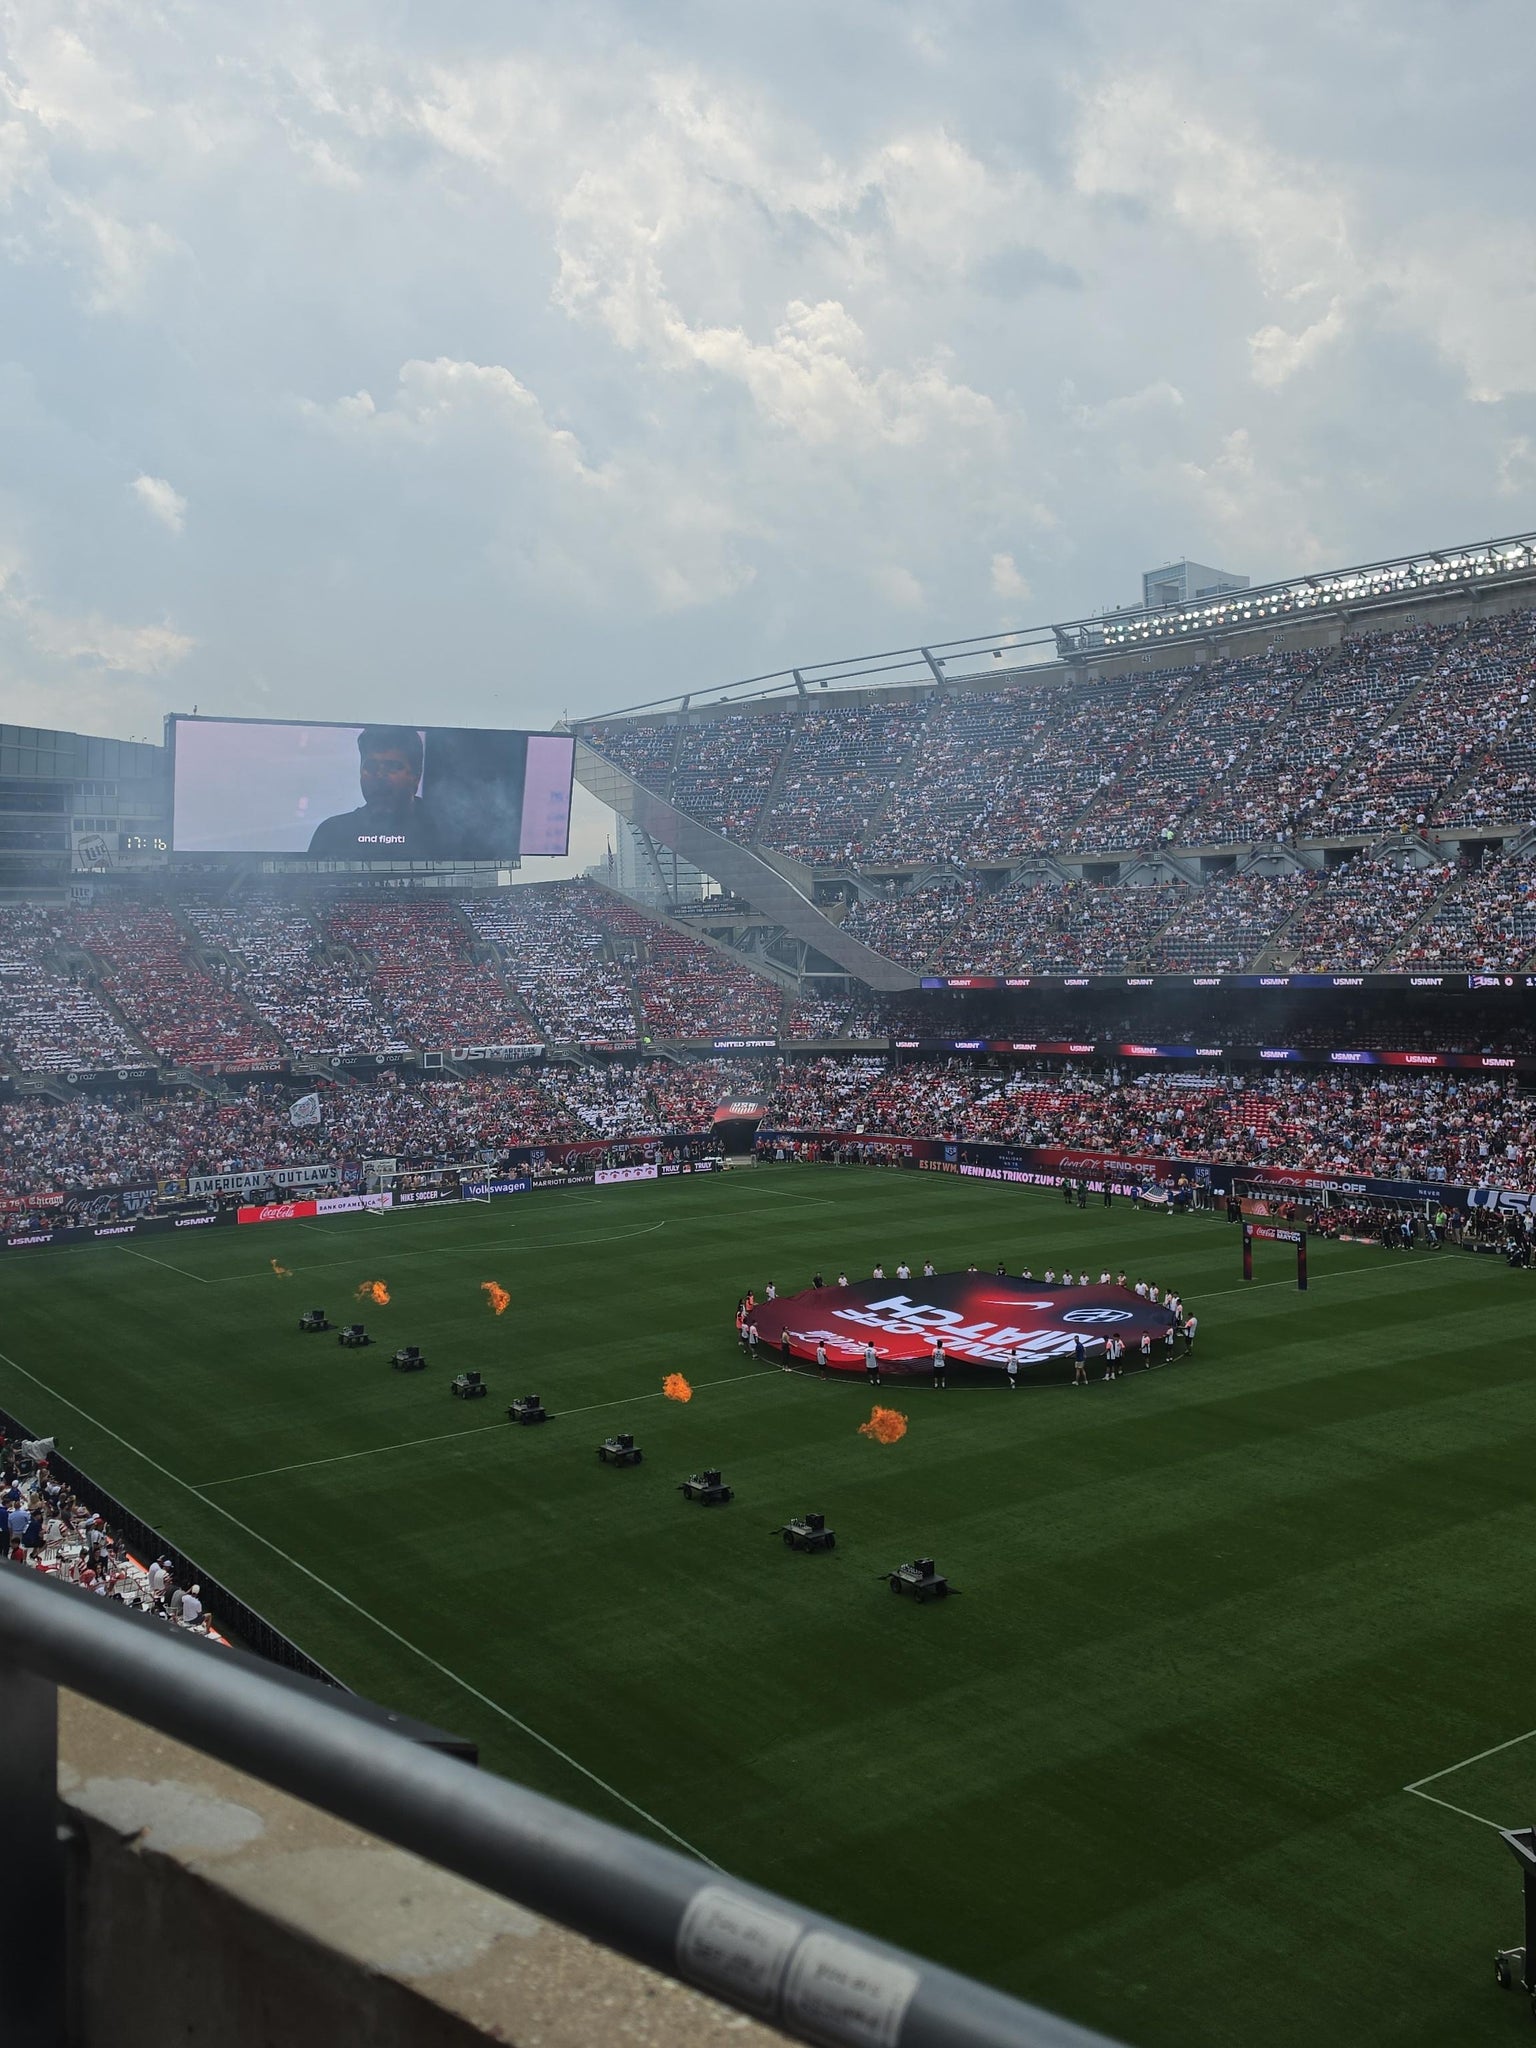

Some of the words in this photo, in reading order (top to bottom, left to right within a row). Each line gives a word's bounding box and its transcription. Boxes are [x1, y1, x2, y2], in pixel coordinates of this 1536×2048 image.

[358, 835, 377, 843] and
[1193, 978, 1221, 986] USMNT
[1260, 978, 1289, 986] USMNT
[1333, 977, 1364, 986] USMNT
[1410, 977, 1443, 986] USMNT
[1481, 978, 1500, 986] USA
[1013, 1043, 1037, 1051] USMNT
[1331, 1053, 1361, 1061] USMNT
[1405, 1055, 1437, 1064] USMNT
[1482, 1058, 1515, 1067] USMNT
[79, 1073, 97, 1081] razr
[129, 1070, 147, 1078] razr
[661, 1165, 679, 1173] TRULY
[1103, 1160, 1156, 1172] SEND-OFF
[919, 1160, 929, 1169] ES
[930, 1161, 941, 1170] IST
[942, 1163, 959, 1174] WM,
[960, 1164, 984, 1177] WENN
[985, 1168, 1001, 1179] DAS
[1003, 1170, 1034, 1183] TRIKOT
[1035, 1174, 1054, 1186] ZUM
[193, 1174, 260, 1192] AMERICAN
[278, 1167, 338, 1184] OUTLAWS
[533, 1178, 566, 1188] MARRIOTT
[469, 1182, 525, 1195] Volkswagen
[1305, 1179, 1366, 1192] SEND-OFF
[400, 1193, 416, 1203] NIKE
[416, 1190, 438, 1200] SOCCER
[29, 1195, 64, 1208] Chicago
[347, 1199, 376, 1208] AMERICA
[175, 1216, 217, 1227] USMNT
[94, 1225, 136, 1236] USMNT
[7, 1234, 54, 1246] USMNT
